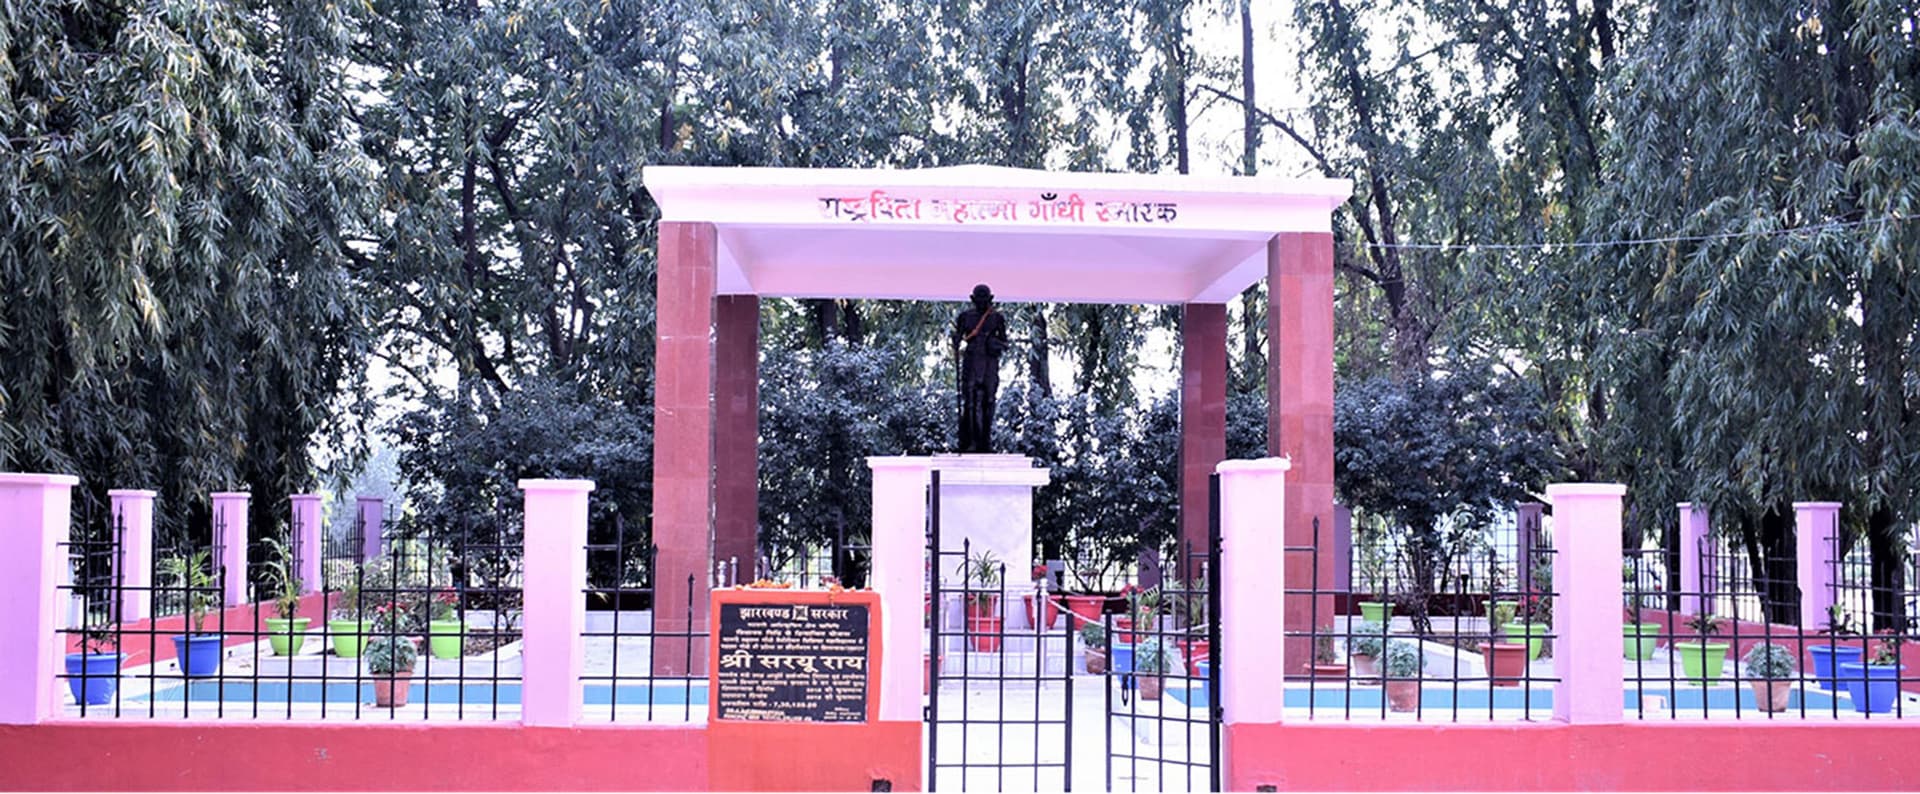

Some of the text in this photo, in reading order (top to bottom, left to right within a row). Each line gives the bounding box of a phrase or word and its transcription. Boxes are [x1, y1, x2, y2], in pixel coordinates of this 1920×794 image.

[810, 609, 848, 620] सरकार
[720, 650, 865, 673] श्री सरयू राय
